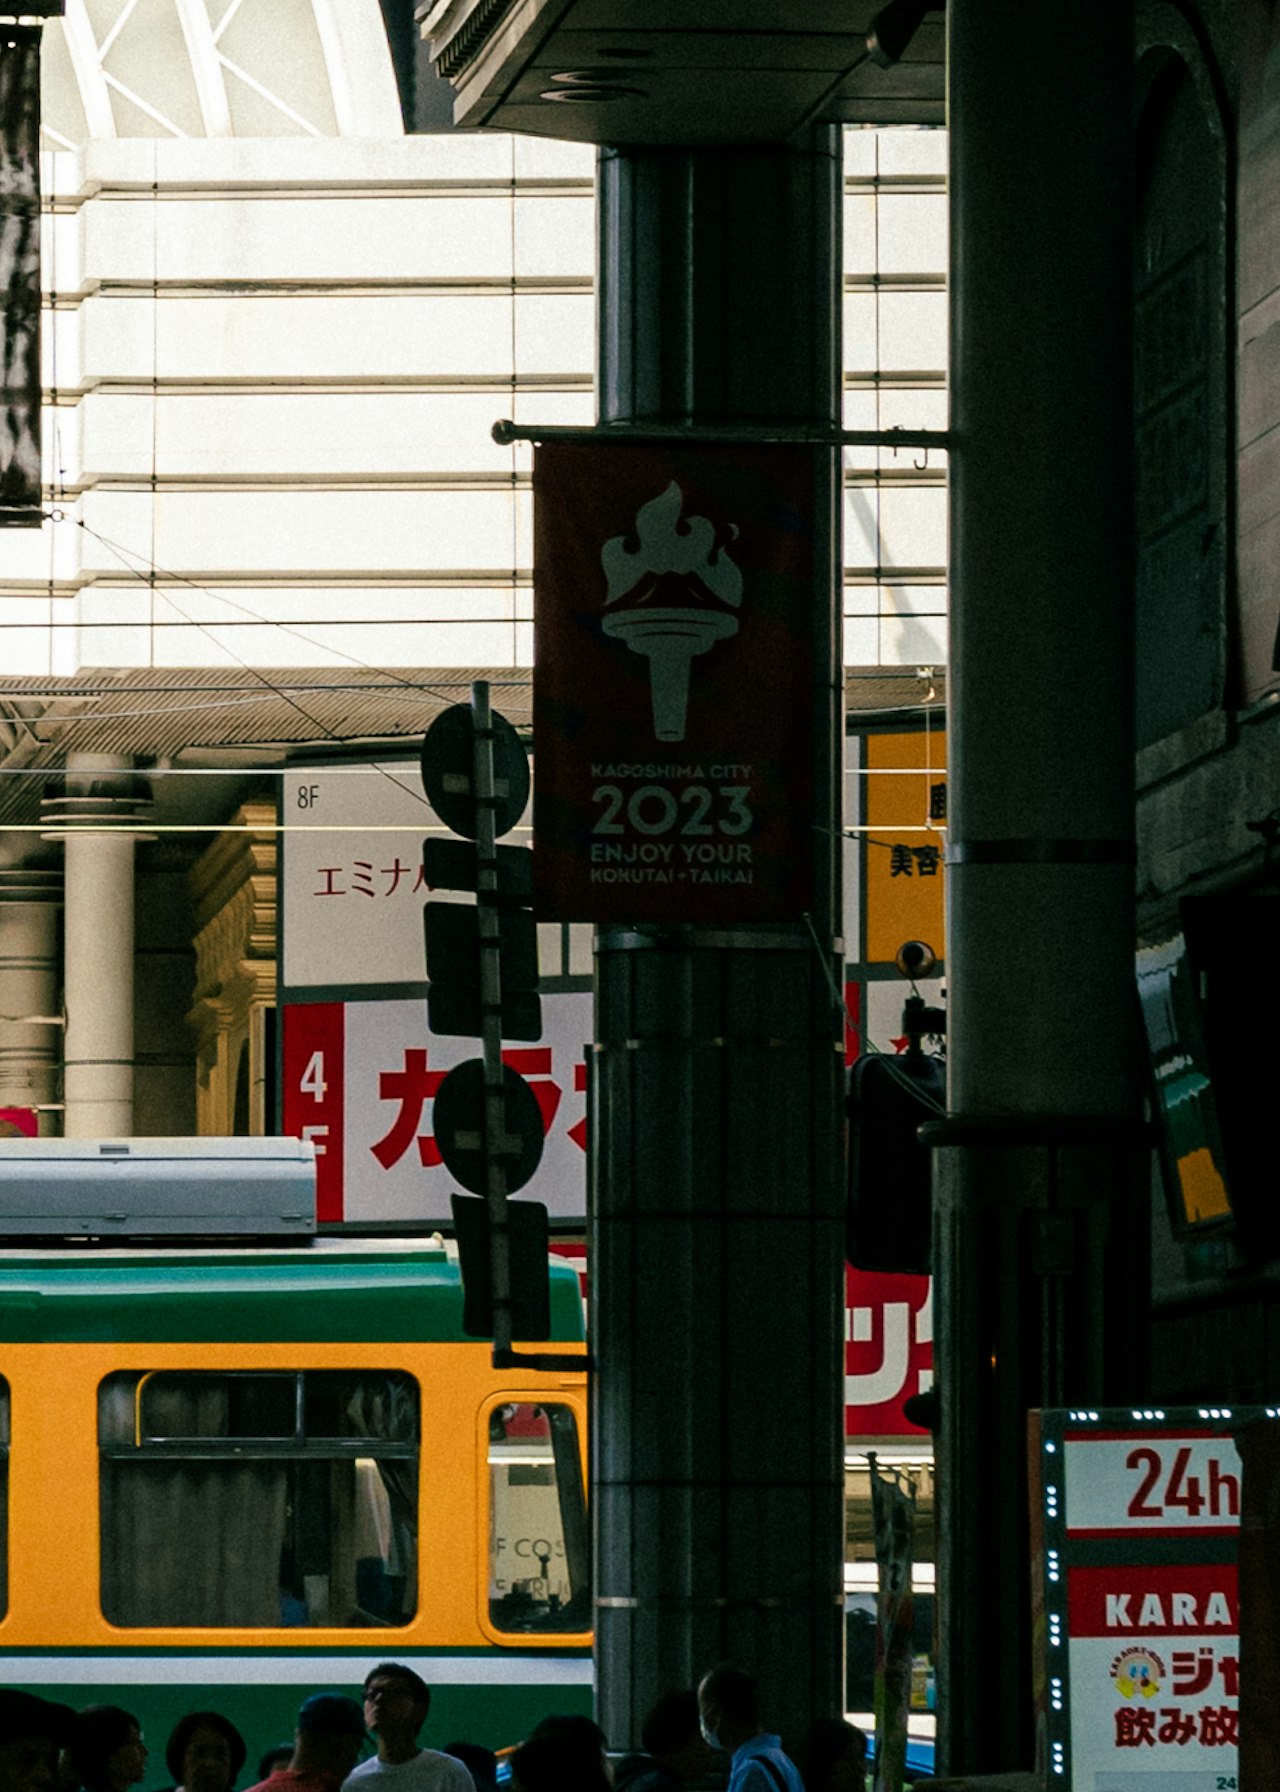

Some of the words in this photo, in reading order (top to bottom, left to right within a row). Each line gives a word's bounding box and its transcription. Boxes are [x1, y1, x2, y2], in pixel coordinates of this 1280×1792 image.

[592, 764, 705, 780] KAGOSHIMA
[710, 764, 753, 780] CITY
[298, 786, 319, 809] 8F
[592, 784, 754, 836] 2023
[592, 843, 674, 863] ENJOY
[680, 843, 754, 863] YOUR
[371, 1049, 587, 1169] カラ
[1105, 1592, 1233, 1628] KARA
